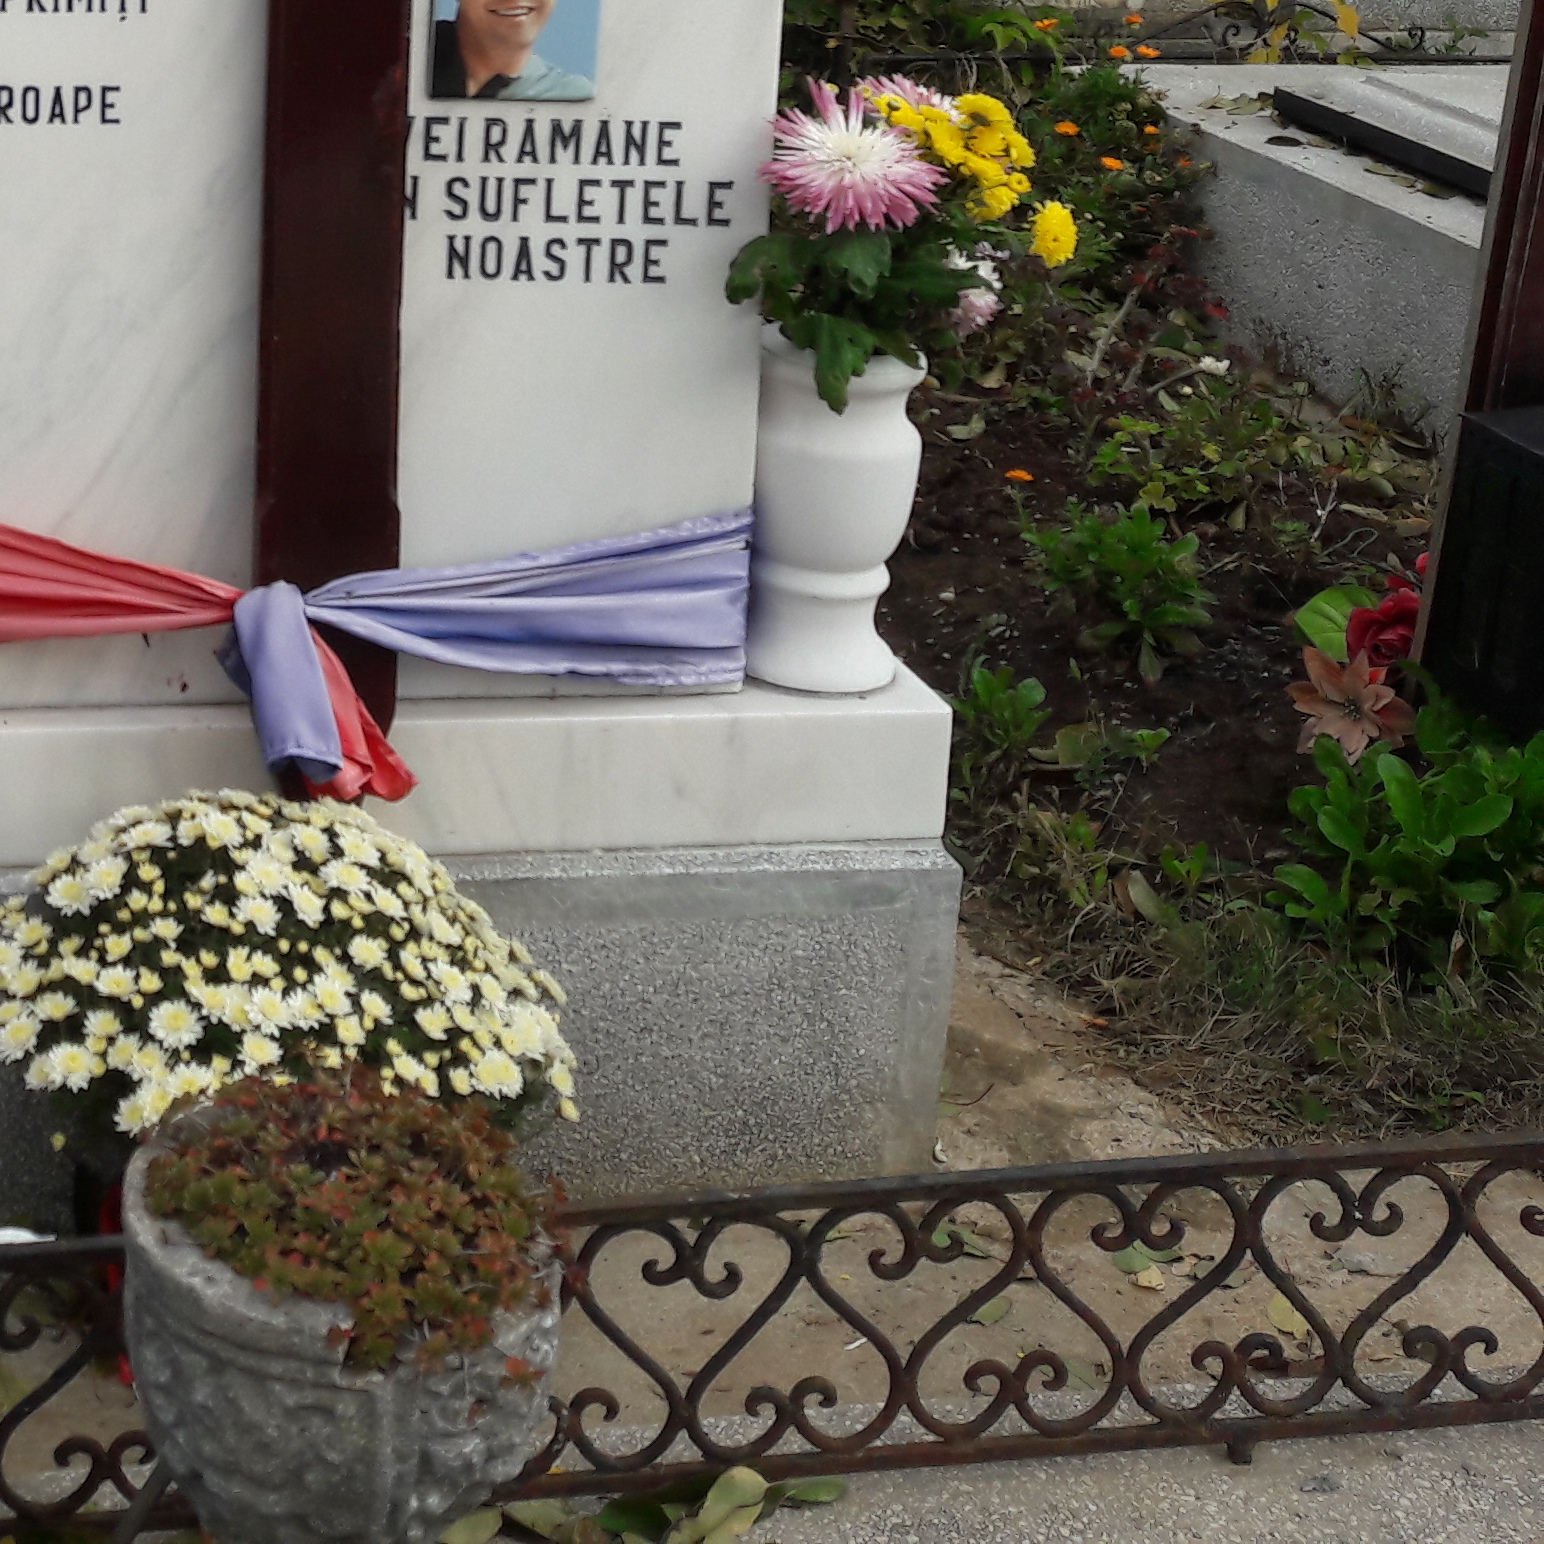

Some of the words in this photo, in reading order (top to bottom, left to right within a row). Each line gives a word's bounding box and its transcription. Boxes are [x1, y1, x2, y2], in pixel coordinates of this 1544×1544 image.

[407, 115, 468, 164] EI
[443, 176, 736, 227] SUFLETELE
[445, 234, 669, 284] NOASTRE
